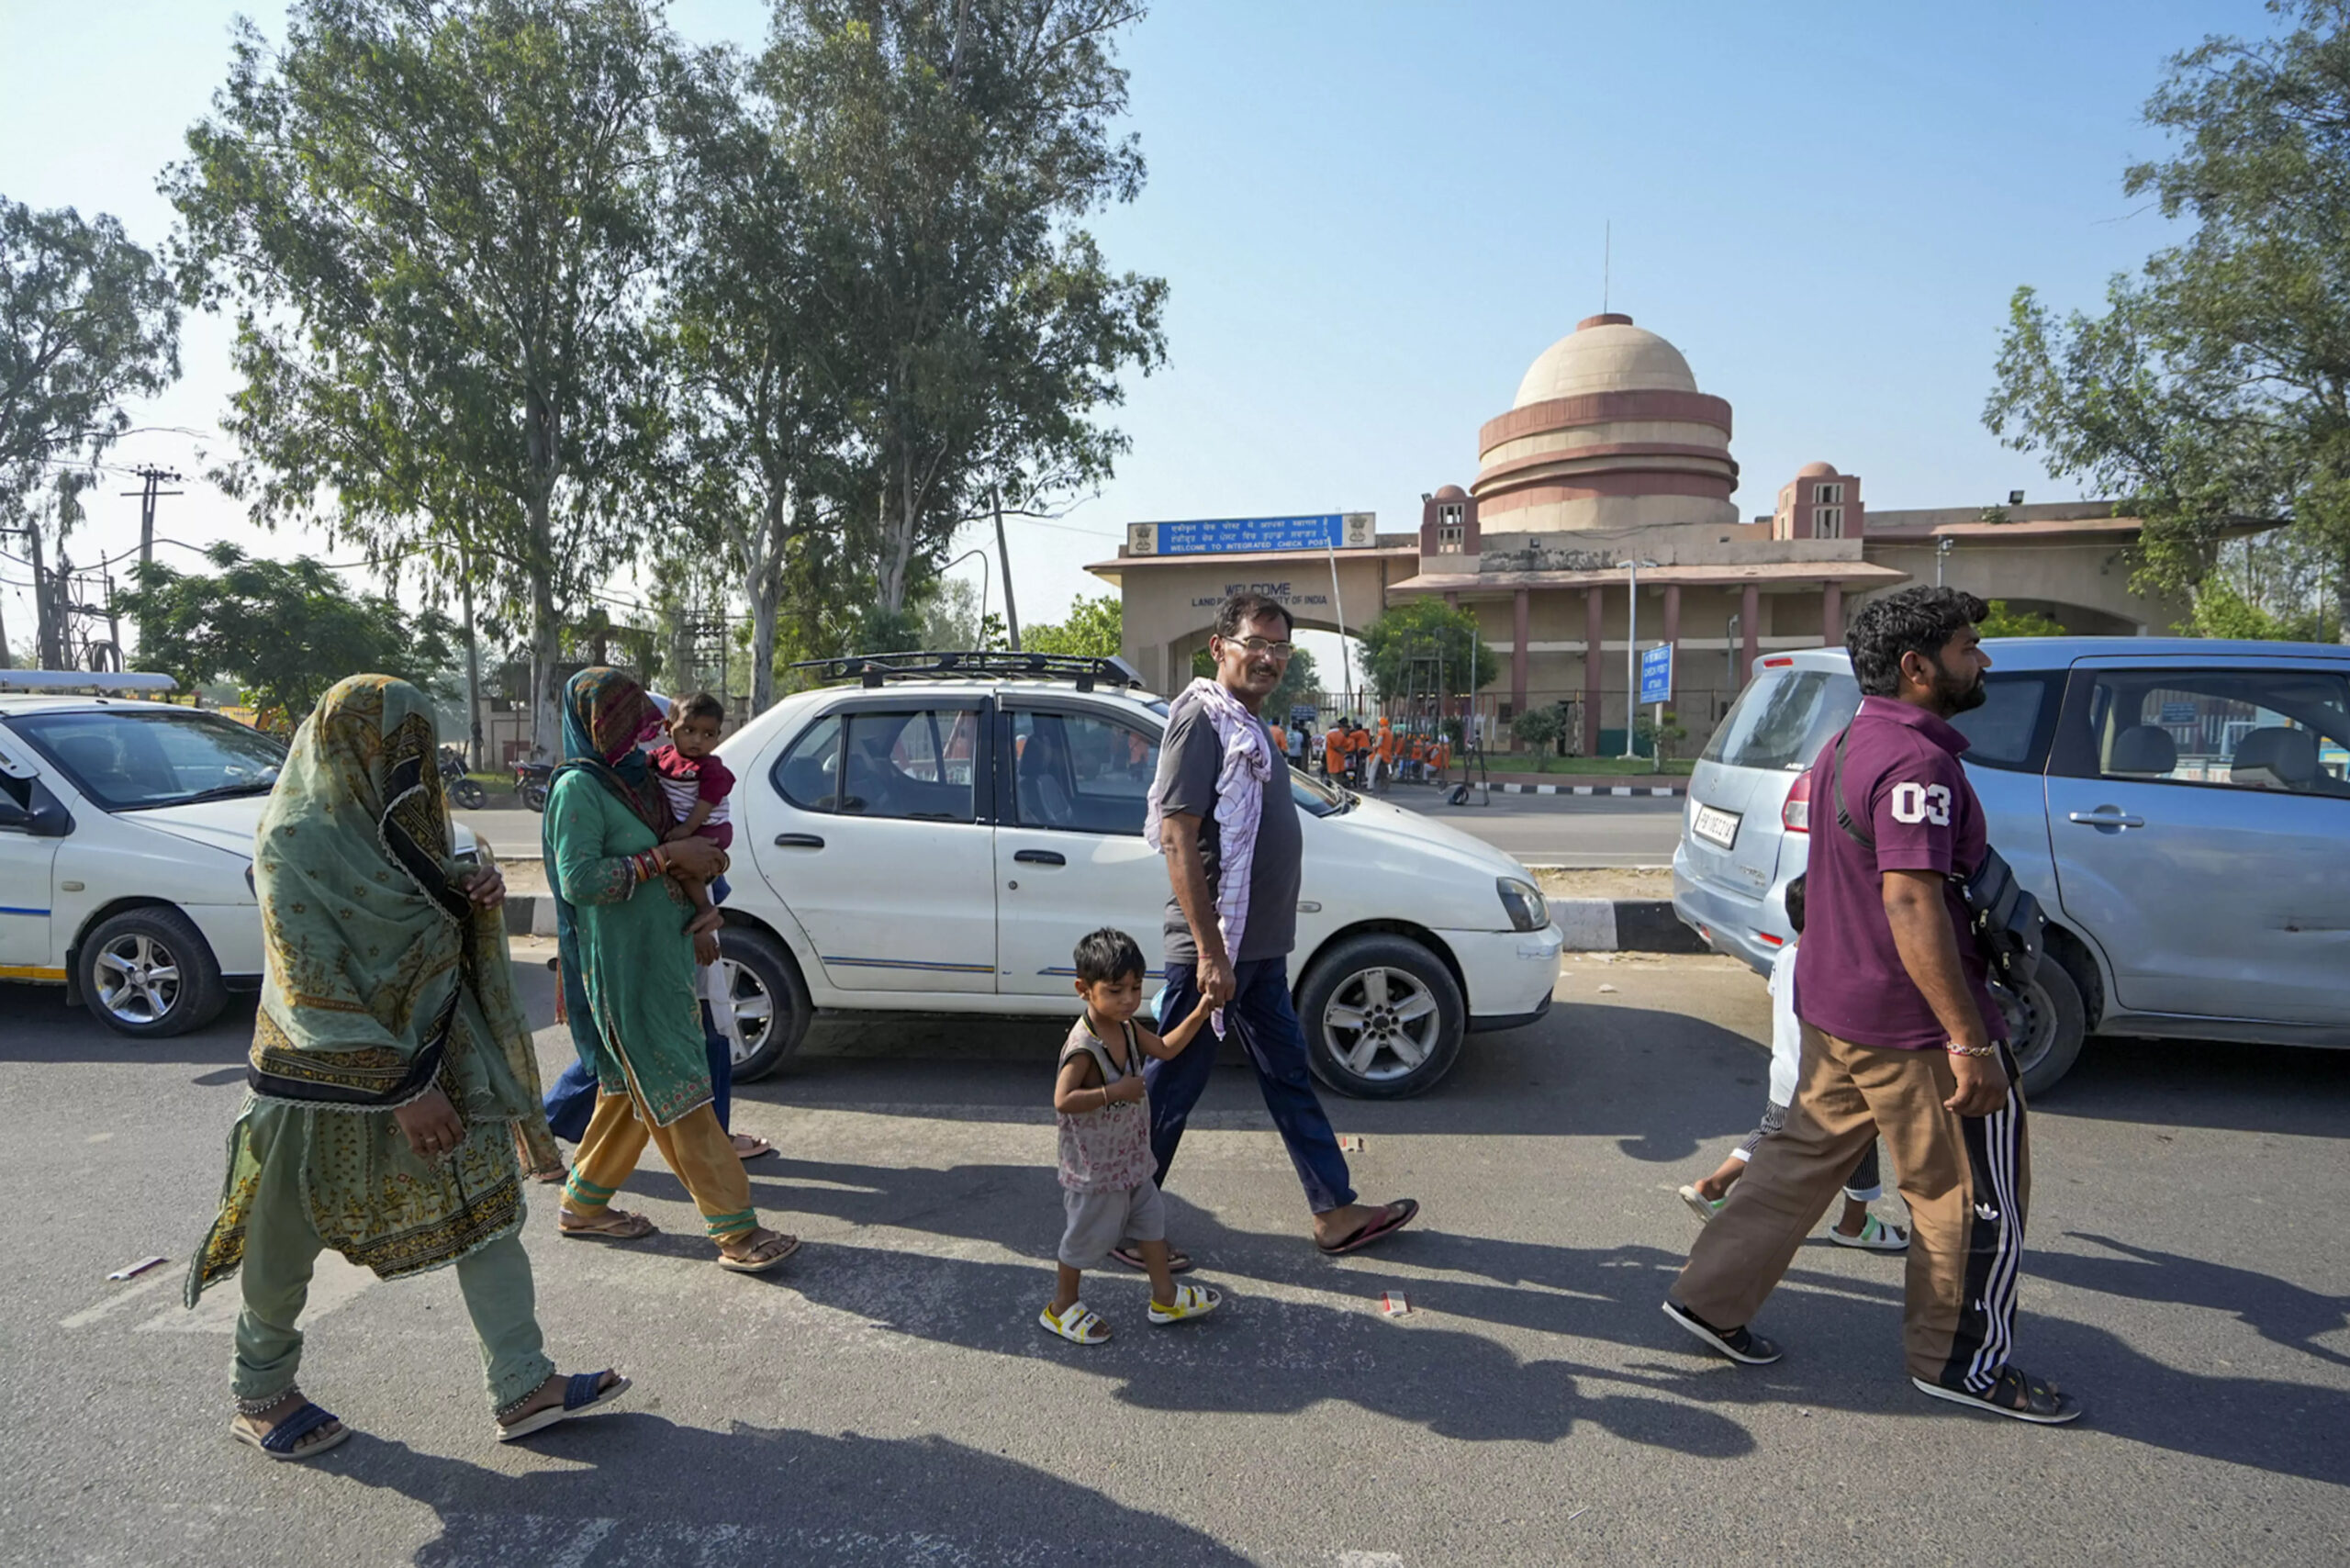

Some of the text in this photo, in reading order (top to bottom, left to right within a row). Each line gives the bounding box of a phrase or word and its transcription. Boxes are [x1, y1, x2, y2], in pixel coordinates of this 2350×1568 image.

[1170, 543, 1205, 552] WELCOME
[1226, 541, 1271, 550] INTEGRATED
[1192, 598, 1216, 607] LAND
[1292, 596, 1301, 604] OF
[1304, 595, 1327, 605] INDIA
[1891, 781, 1952, 827] 03
